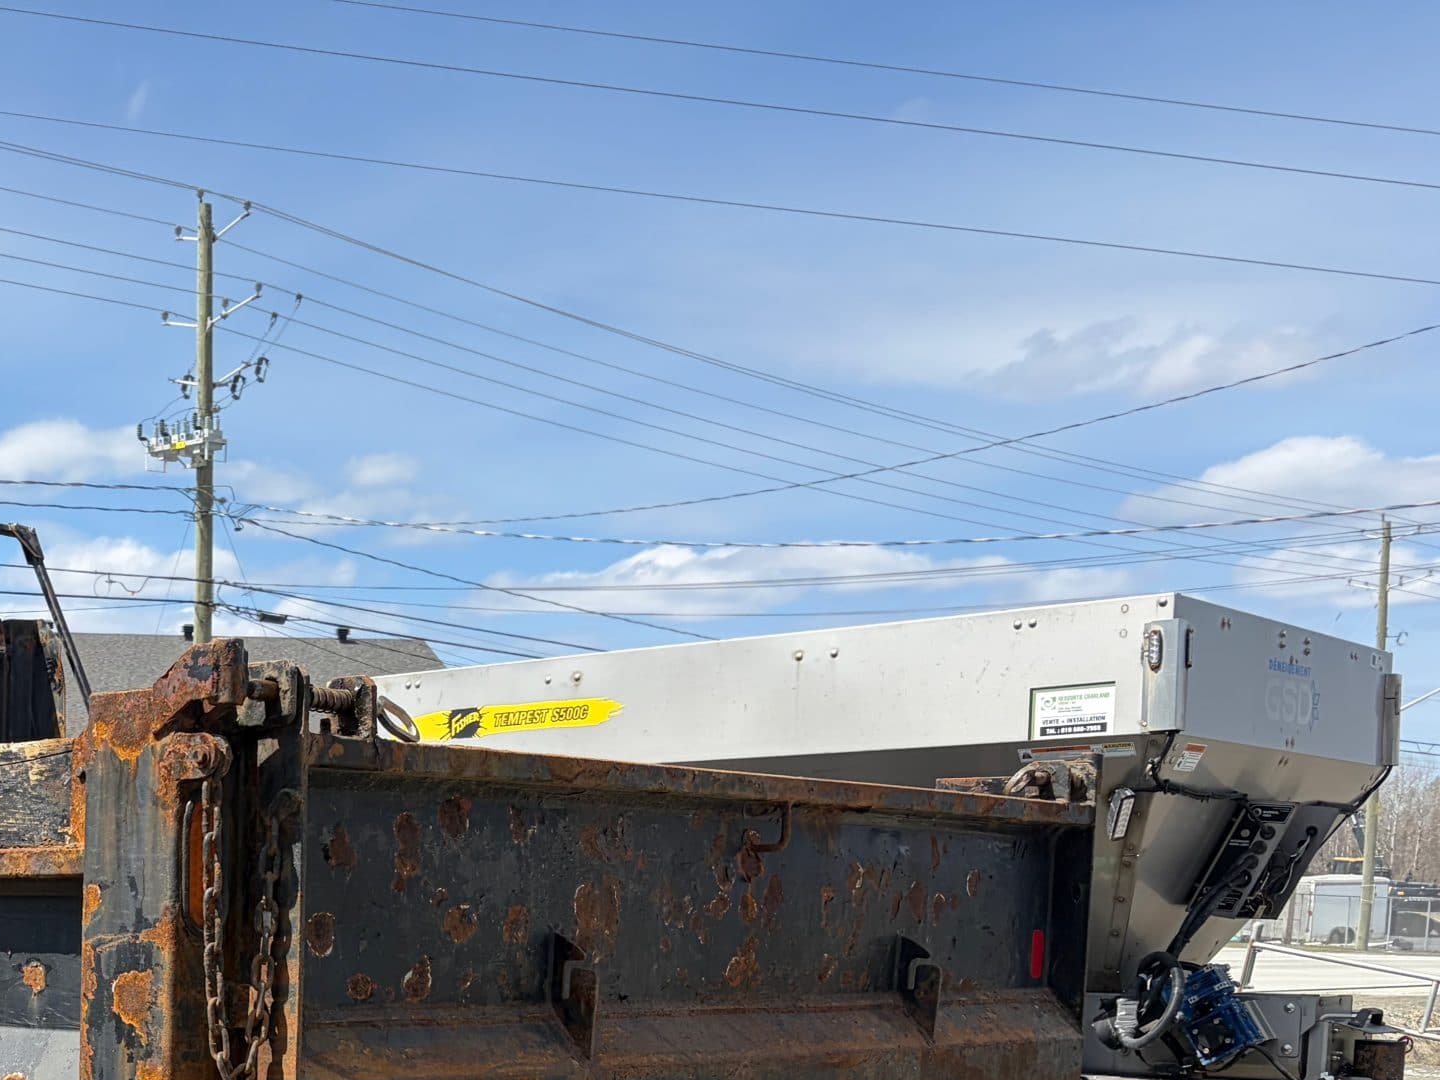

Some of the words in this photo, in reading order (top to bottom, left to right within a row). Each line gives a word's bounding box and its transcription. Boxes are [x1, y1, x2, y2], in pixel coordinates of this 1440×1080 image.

[493, 709, 549, 728] TEMPEST
[551, 705, 590, 724] S500C
[1066, 715, 1106, 724] INSTALLATION
